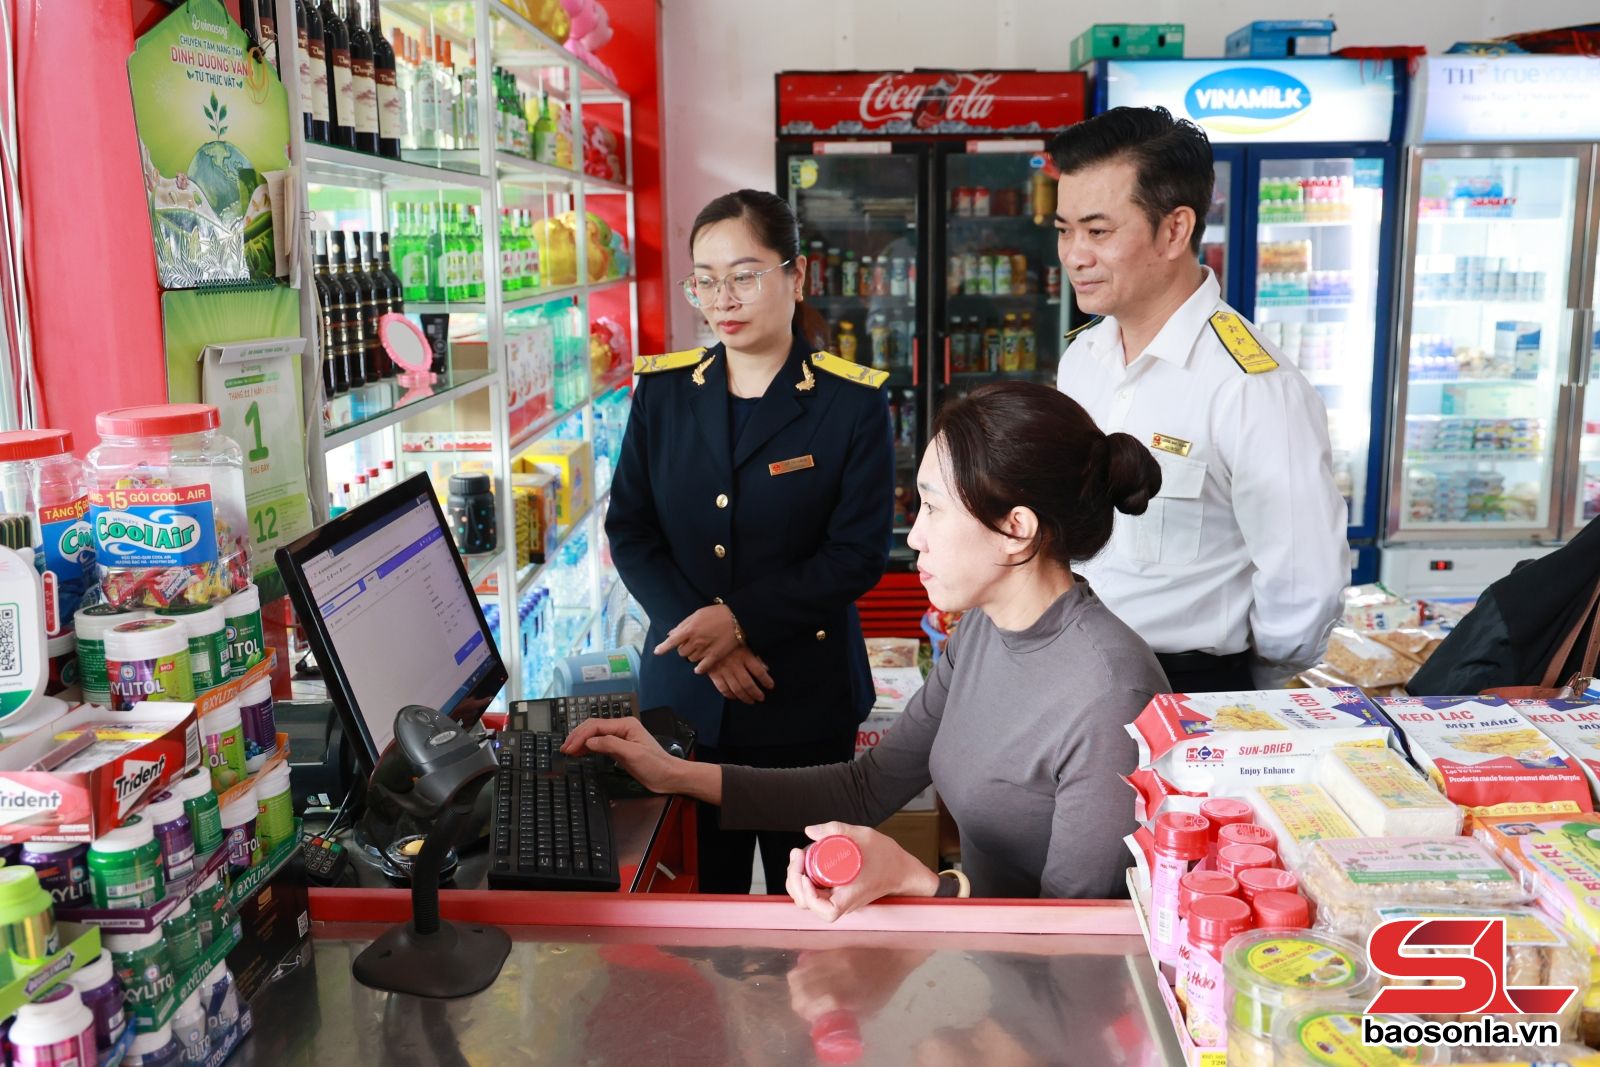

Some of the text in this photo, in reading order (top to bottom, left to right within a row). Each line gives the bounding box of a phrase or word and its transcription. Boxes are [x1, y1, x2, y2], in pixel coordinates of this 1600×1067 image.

[1195, 86, 1303, 110] VINAMILK
[244, 401, 270, 462] 1
[107, 491, 128, 509] 15
[129, 490, 150, 503] GÓI
[152, 491, 184, 503] COOL
[186, 488, 206, 500] AIR
[44, 506, 75, 521] TẶNG
[98, 516, 195, 550] Cool Air
[254, 506, 279, 543] 12
[109, 679, 166, 697] XYLITOL
[1398, 710, 1475, 724] KẸO LẠC
[1530, 713, 1564, 725] KẸO
[1186, 742, 1293, 760] HCA SUN-DRIED
[115, 756, 165, 799] Trident
[1240, 766, 1296, 776] Enjoy Enhance
[1449, 775, 1480, 784] Products
[1558, 774, 1581, 783] Purple
